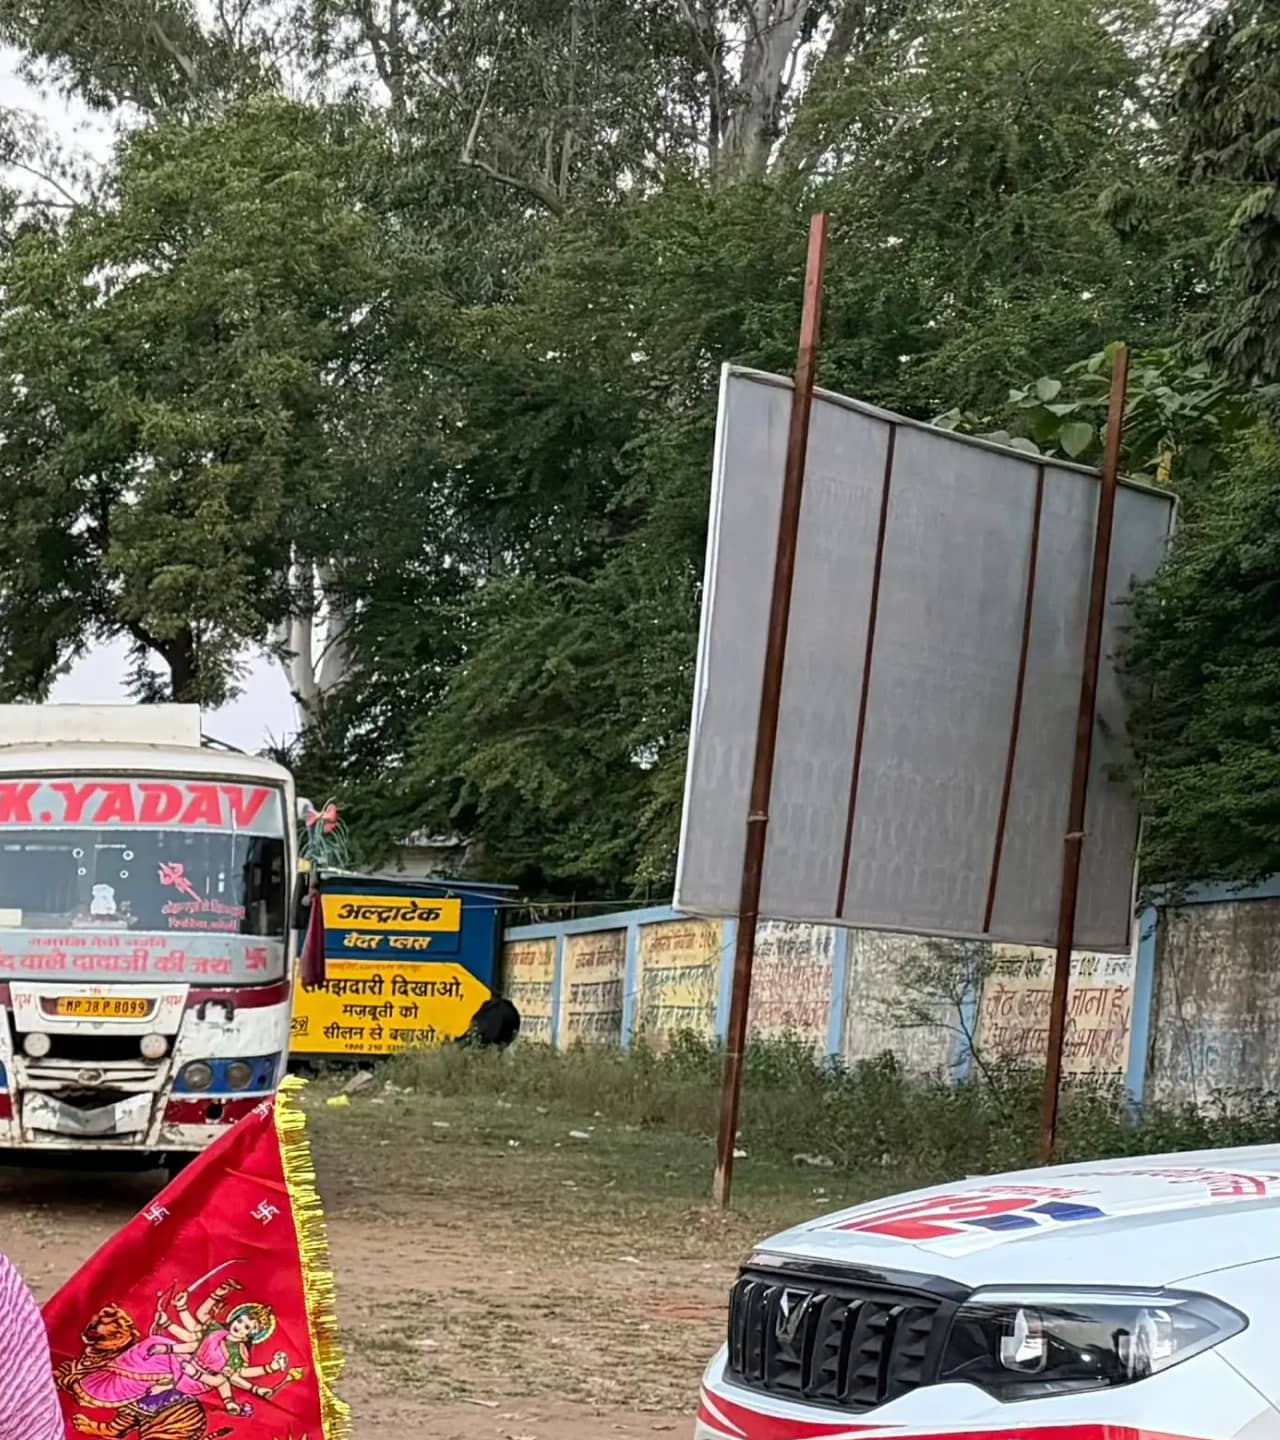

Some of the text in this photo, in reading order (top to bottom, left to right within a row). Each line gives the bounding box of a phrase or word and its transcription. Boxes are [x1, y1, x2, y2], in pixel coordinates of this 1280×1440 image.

[337, 901, 442, 923] अल्ट्राटेक
[388, 934, 432, 949] प्लस
[72, 948, 148, 972] दादाजी
[154, 950, 185, 972] की
[190, 957, 231, 974] जय
[66, 1001, 81, 1012] MP
[399, 1002, 419, 1019] को
[323, 1022, 364, 1040] सीलन
[369, 1024, 383, 1040] से
